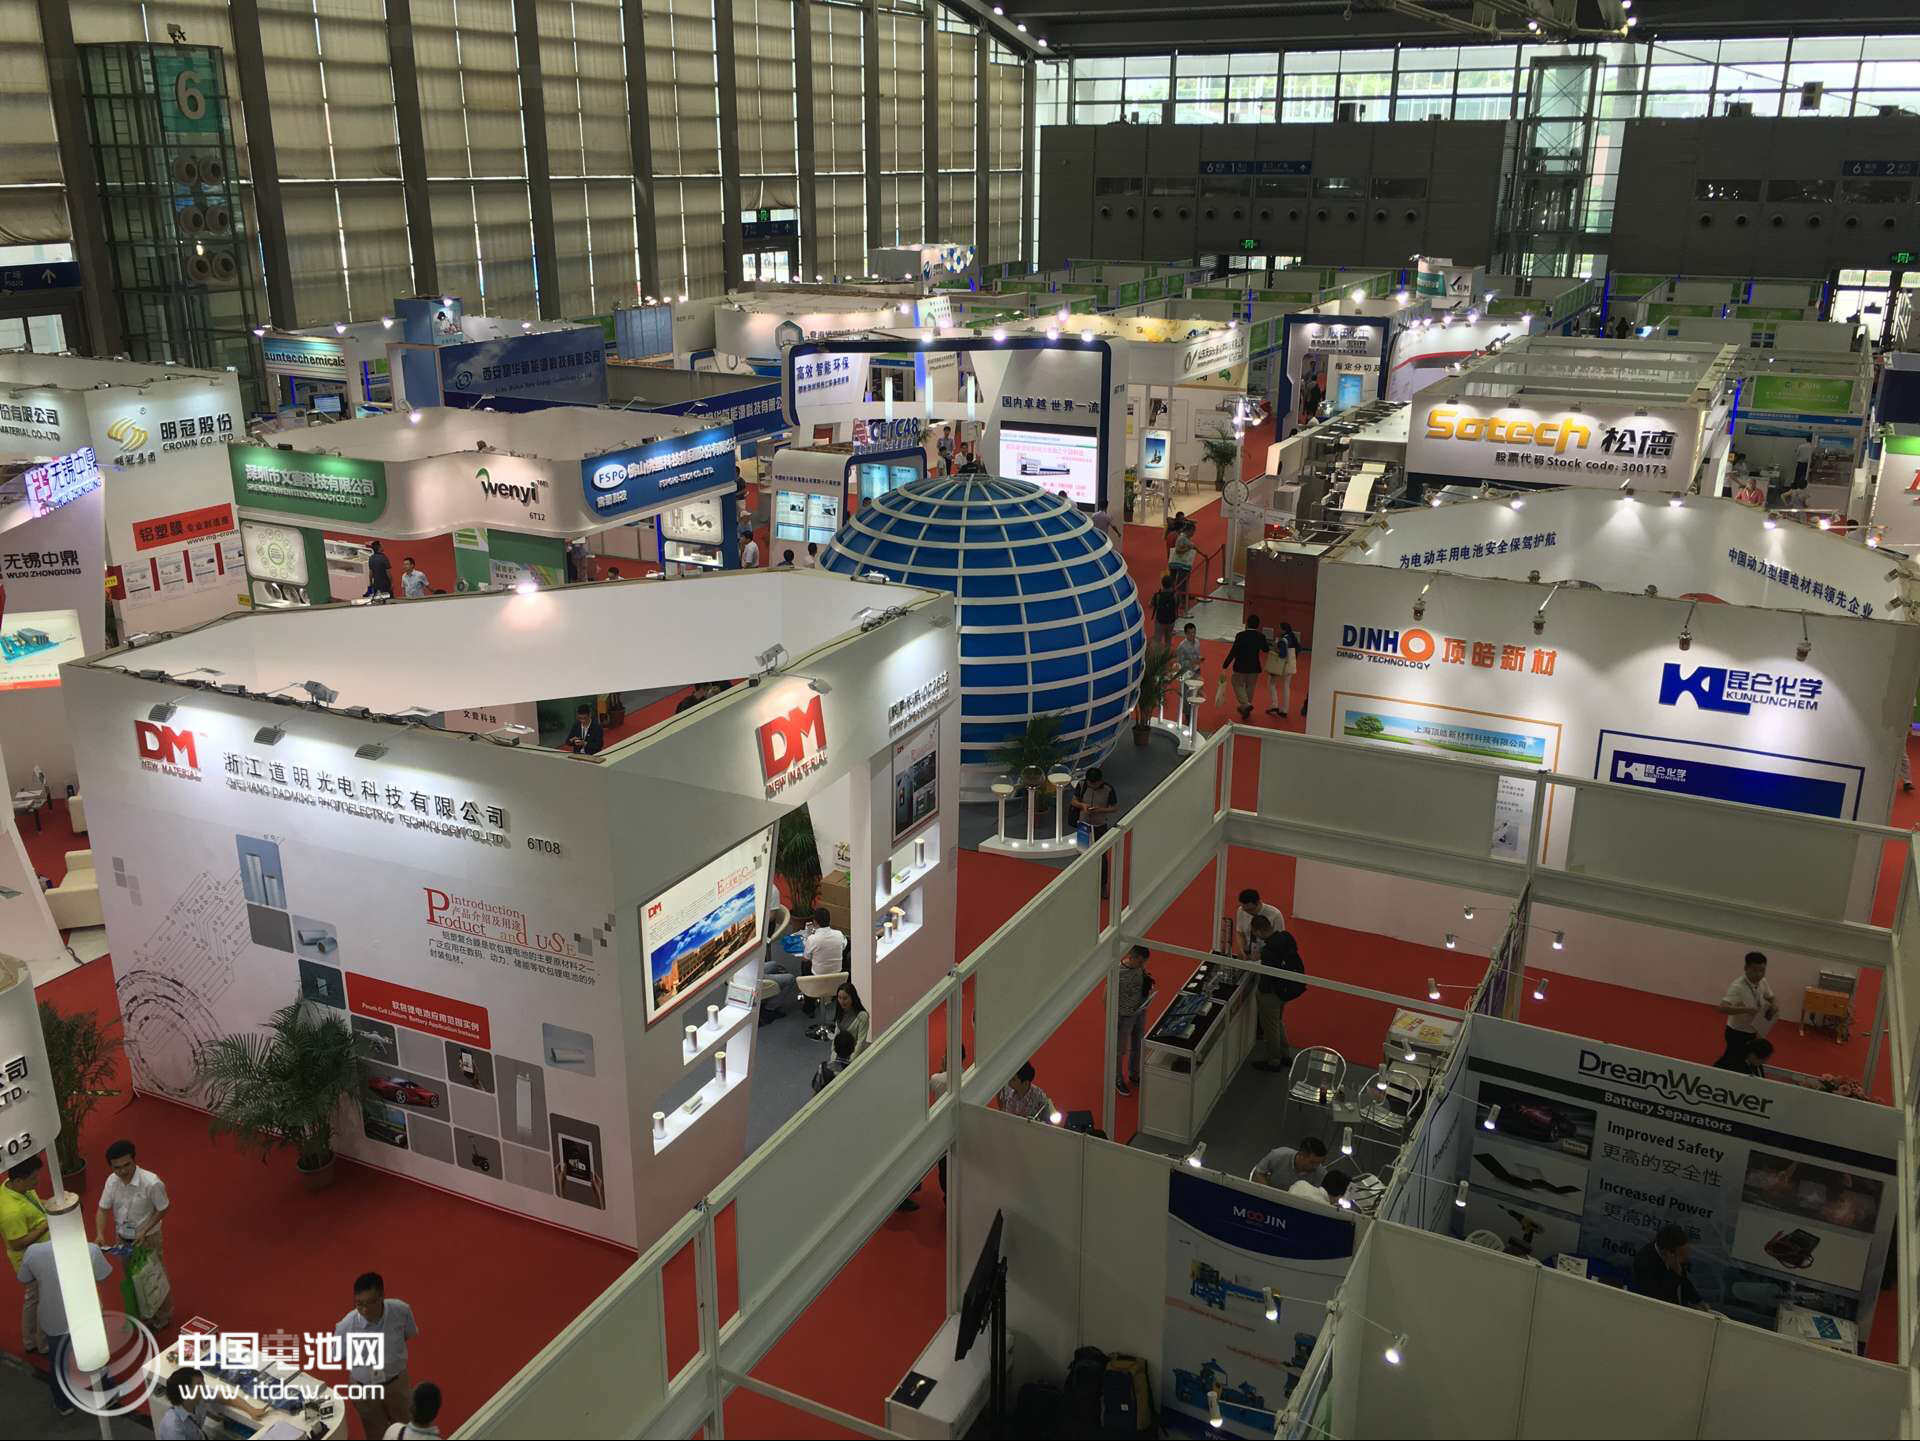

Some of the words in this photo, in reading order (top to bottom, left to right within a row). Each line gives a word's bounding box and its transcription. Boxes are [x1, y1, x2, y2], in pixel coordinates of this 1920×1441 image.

[175, 70, 206, 120] 6
[1206, 162, 1214, 173] 6
[1852, 162, 1862, 174] 6
[1886, 162, 1895, 174] 2
[816, 360, 832, 376] 智能
[833, 356, 849, 372] 环保
[1001, 395, 1047, 410] 国内卓越
[1051, 399, 1100, 414] 世界一流
[160, 413, 233, 440] 明冠股份
[163, 438, 198, 451] CROWN
[1600, 427, 1677, 458] 松德
[599, 470, 624, 483] FSPG
[1495, 451, 1545, 467] 股票代码
[1547, 455, 1582, 470] Stock
[1585, 457, 1619, 472] code:
[1621, 461, 1667, 476] 300173
[477, 473, 538, 504] wenyi
[529, 511, 545, 521] 6T12
[3, 550, 80, 570] 无锡中鼎
[1400, 531, 1557, 569] 为电动车用电池安全保驾护航
[31, 567, 82, 578] ZHONGDING
[1728, 547, 1874, 619] 中国动力型锂电材料领先企业
[1342, 624, 1436, 662] DINHO
[1441, 637, 1558, 677] 顶皓新材
[1336, 651, 1364, 661] DINHO
[1367, 655, 1431, 671] TECHNOLOGY
[1727, 670, 1823, 700] 昆仑化学
[1726, 690, 1819, 711] KUNLUNCHEM
[135, 720, 199, 769] DM
[760, 694, 827, 779] DM
[223, 751, 506, 829] 浙江道明光电科技有限公司
[527, 837, 561, 855] 6T08
[423, 887, 487, 936] Product
[450, 893, 520, 919] Introduction
[451, 905, 521, 932] 产品介绍及用途
[648, 902, 662, 919] DM
[0, 1055, 29, 1088] 司
[1578, 1049, 1774, 1113] DreamWeaver
[1603, 1091, 1655, 1115] Battery
[1657, 1106, 1733, 1133] Separators
[0, 1132, 32, 1162] 03
[1607, 1120, 1674, 1148] Improved
[1677, 1139, 1725, 1163] Safety
[1601, 1142, 1723, 1188] 更高的安全性
[1599, 1178, 1666, 1206] Increased
[1668, 1196, 1714, 1219] Power
[1602, 1237, 1637, 1257] Redu
